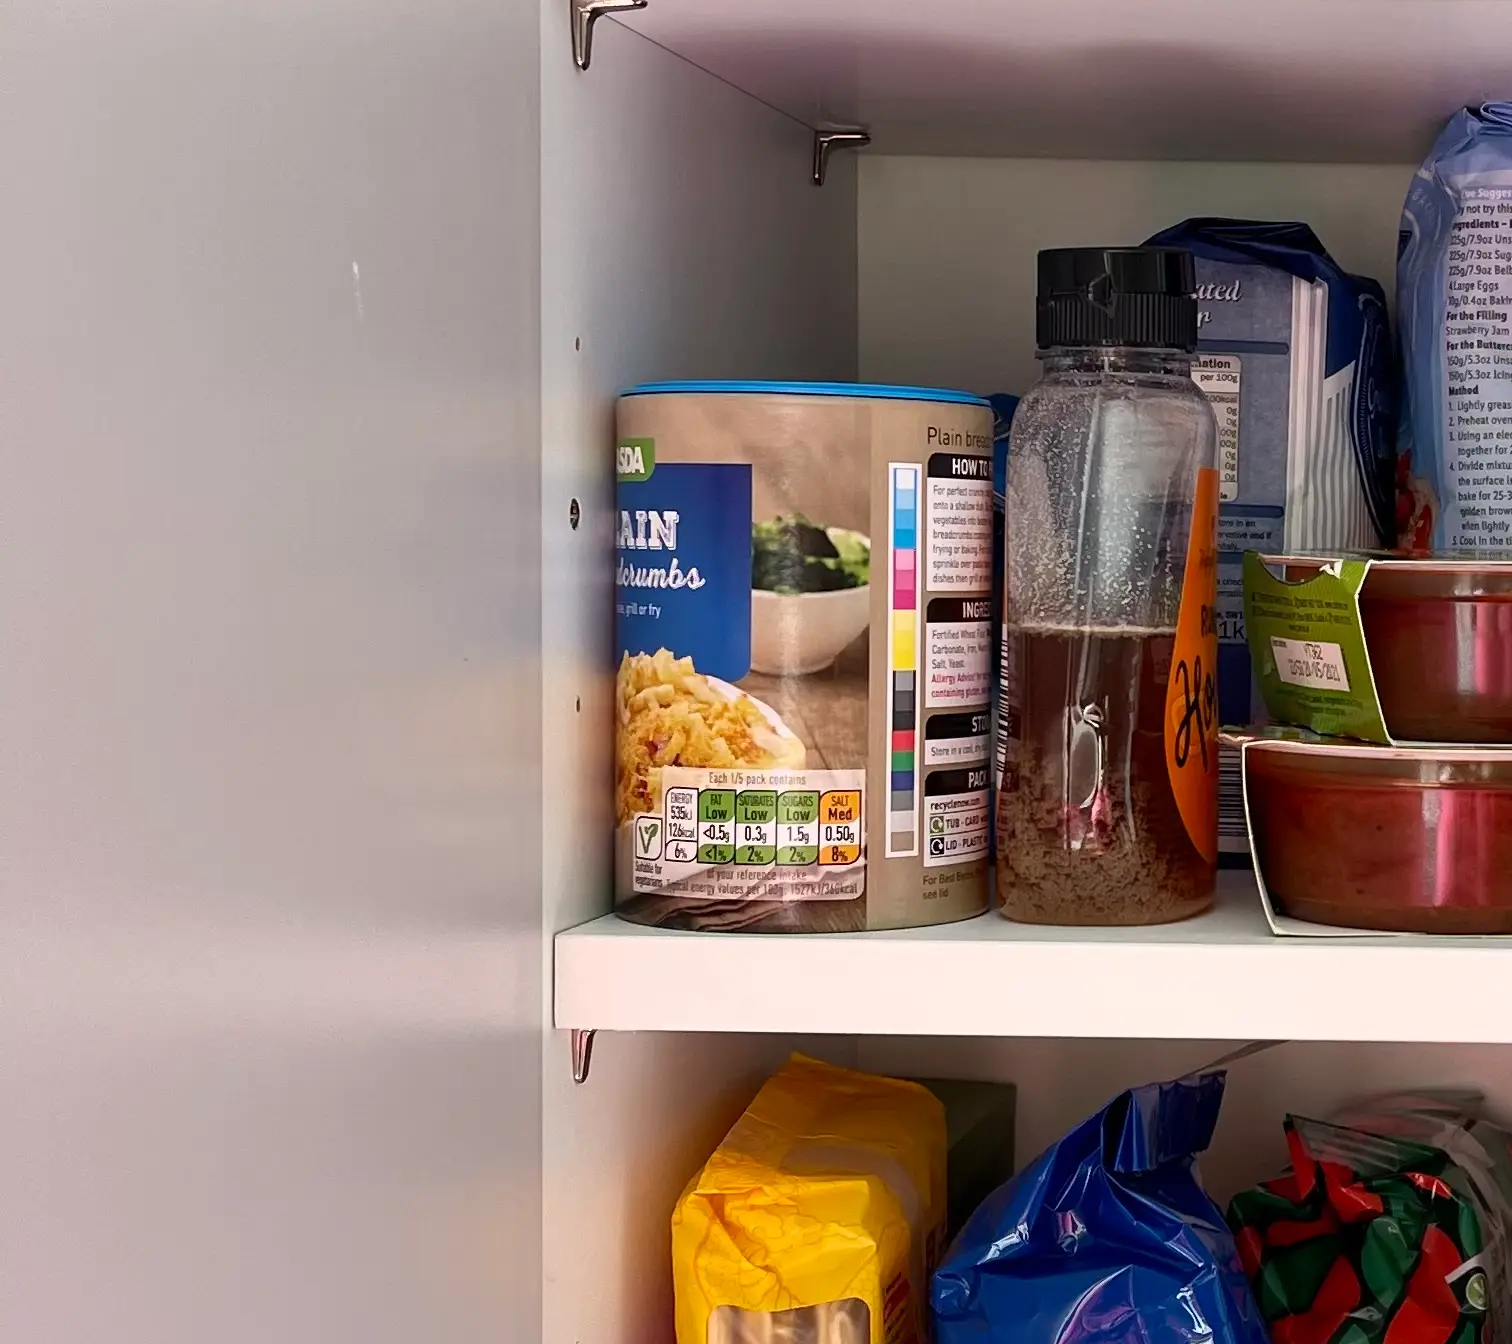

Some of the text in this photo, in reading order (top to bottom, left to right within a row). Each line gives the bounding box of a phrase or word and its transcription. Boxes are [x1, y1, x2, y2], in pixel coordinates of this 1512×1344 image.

[1466, 205, 1480, 214] not
[927, 426, 962, 446] Plain
[952, 458, 978, 476] HOW
[709, 772, 726, 785] Each
[746, 774, 765, 787] pack
[769, 773, 806, 786] contains
[705, 807, 853, 821] Low Low Low Med
[744, 826, 855, 844] 0.3g 1.5g 0.50g
